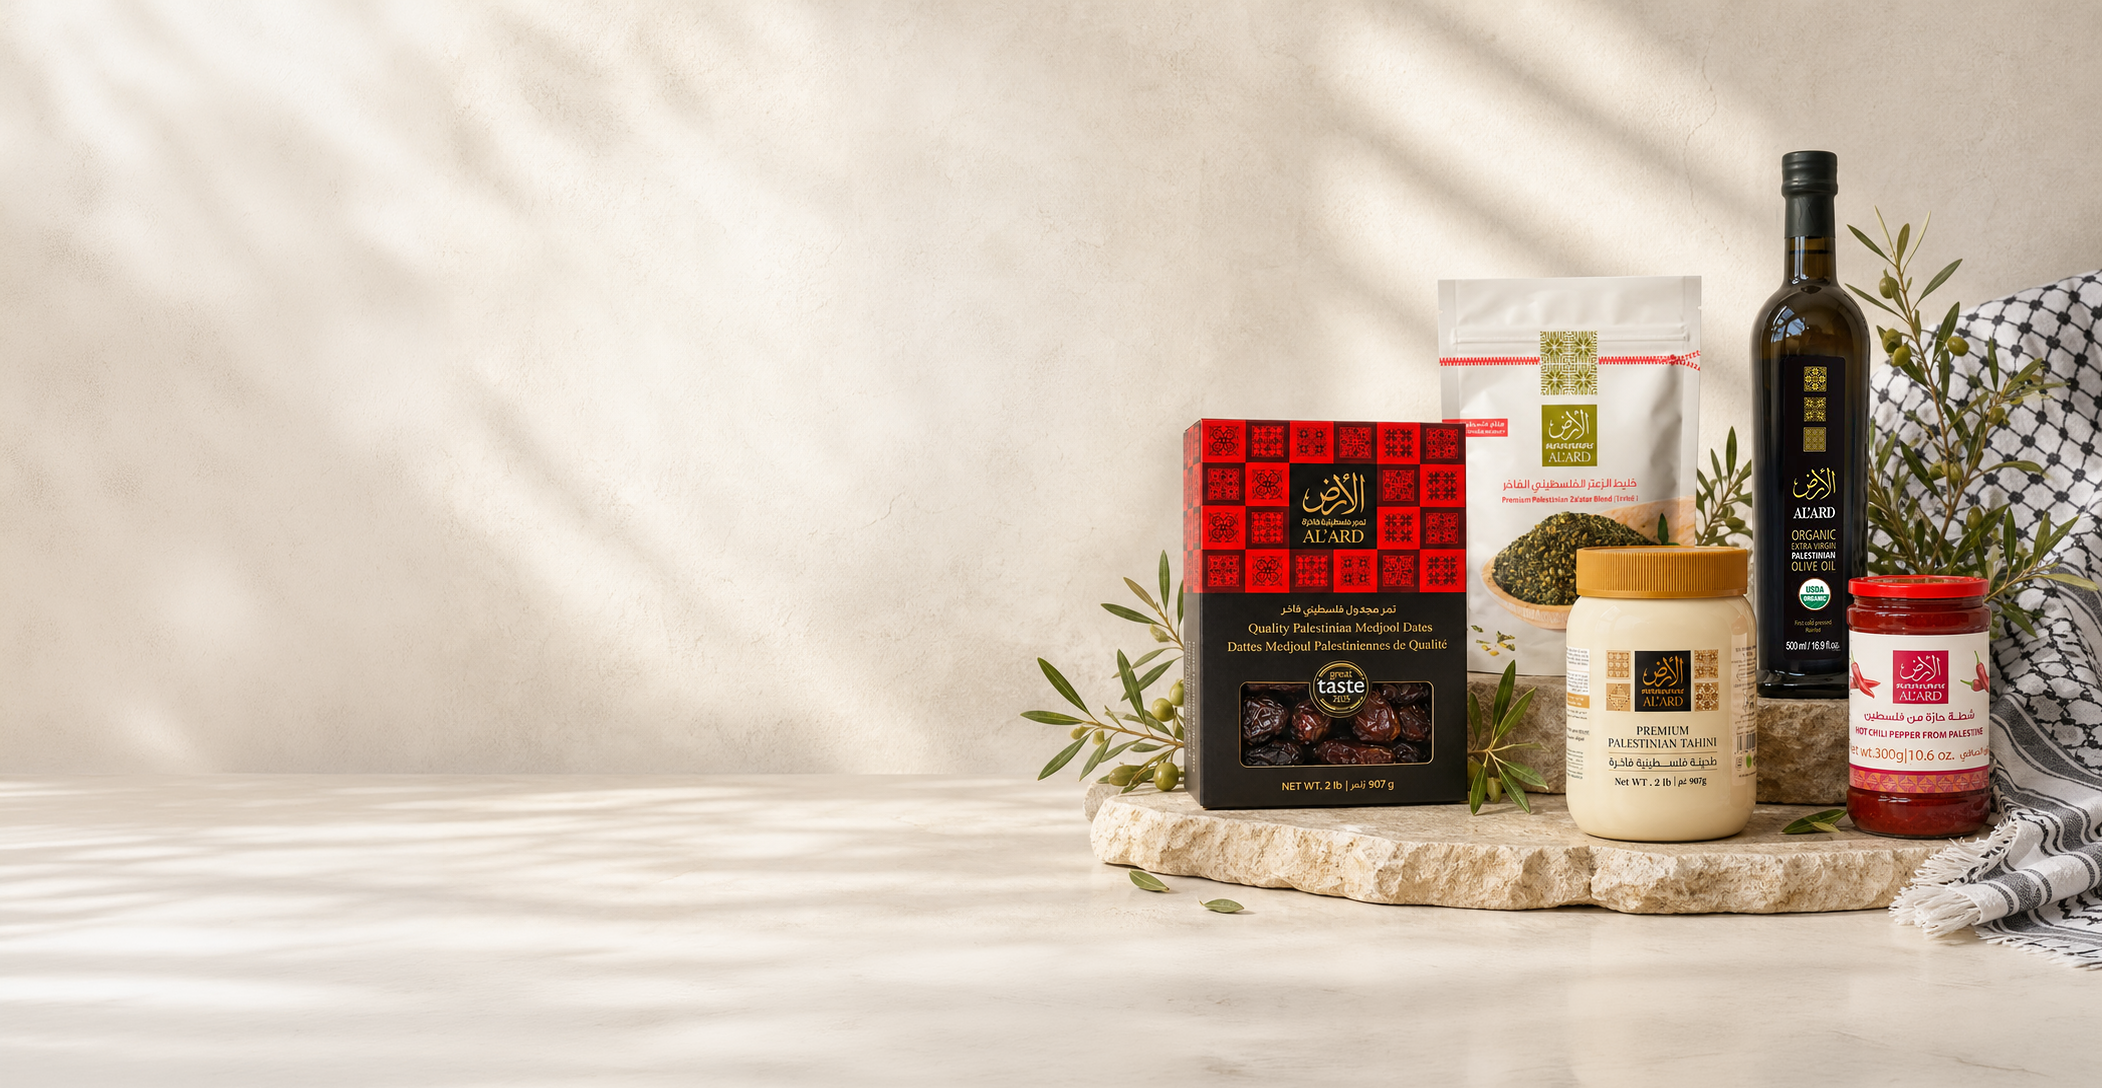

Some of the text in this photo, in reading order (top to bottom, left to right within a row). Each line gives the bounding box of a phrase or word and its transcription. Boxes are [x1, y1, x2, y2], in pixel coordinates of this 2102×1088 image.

[1549, 409, 1589, 441] الأرض
[1548, 451, 1591, 463] AL'ARD
[1792, 467, 1836, 500] الأرض
[1302, 471, 1366, 516] الأرض
[1792, 506, 1836, 519] AL'ARD
[1302, 529, 1365, 544] AL'ARD
[1791, 529, 1836, 541] ORGANIC
[1791, 542, 1836, 550] EXTRA VIRGIN
[1791, 551, 1836, 560] PALESTINIAN
[1791, 560, 1836, 572] OLIVE OIL
[1805, 585, 1825, 593] USDA
[1280, 604, 1301, 616] فاخر
[1303, 604, 1344, 618] فلسطيني
[1380, 604, 1397, 616] تمر
[1248, 622, 1290, 637] Quality
[1355, 621, 1400, 635] Medjool
[1402, 621, 1433, 633] Dates
[1227, 638, 1448, 654] Dattes Medjoul Palestiniennes de Qualité
[1785, 640, 1798, 651] 500
[1798, 641, 1807, 650] ml
[1811, 640, 1825, 650] 16.9
[1642, 655, 1684, 687] الأرض
[1900, 654, 1941, 682] الأرض
[1317, 679, 1365, 694] taste
[1642, 695, 1684, 707] AL'ARD
[1899, 690, 1943, 701] AL'ARD
[1864, 711, 1905, 722] فلسطين
[1906, 715, 1924, 725] من
[1636, 725, 1689, 736] PREMIUM
[1855, 726, 1868, 736] HOT
[1868, 728, 1888, 738] CHILI
[1889, 730, 1921, 739] PEPPER
[1922, 730, 1947, 739] FROM
[1608, 737, 1717, 748] PALESTINIAN TAHINI
[1850, 745, 1859, 756] et
[1937, 751, 1955, 761] oz.
[1608, 757, 1634, 769] فاخرة
[1281, 781, 1302, 791] NET
[1303, 781, 1323, 791] WT.
[1324, 780, 1331, 790] 2
[1332, 780, 1343, 790] lb
[1367, 779, 1386, 789] 907
[1387, 781, 1395, 791] g
[1615, 777, 1629, 786] Net
[1654, 778, 1660, 787] 2
[1662, 778, 1672, 787] lb
[1689, 777, 1707, 787] 907g
